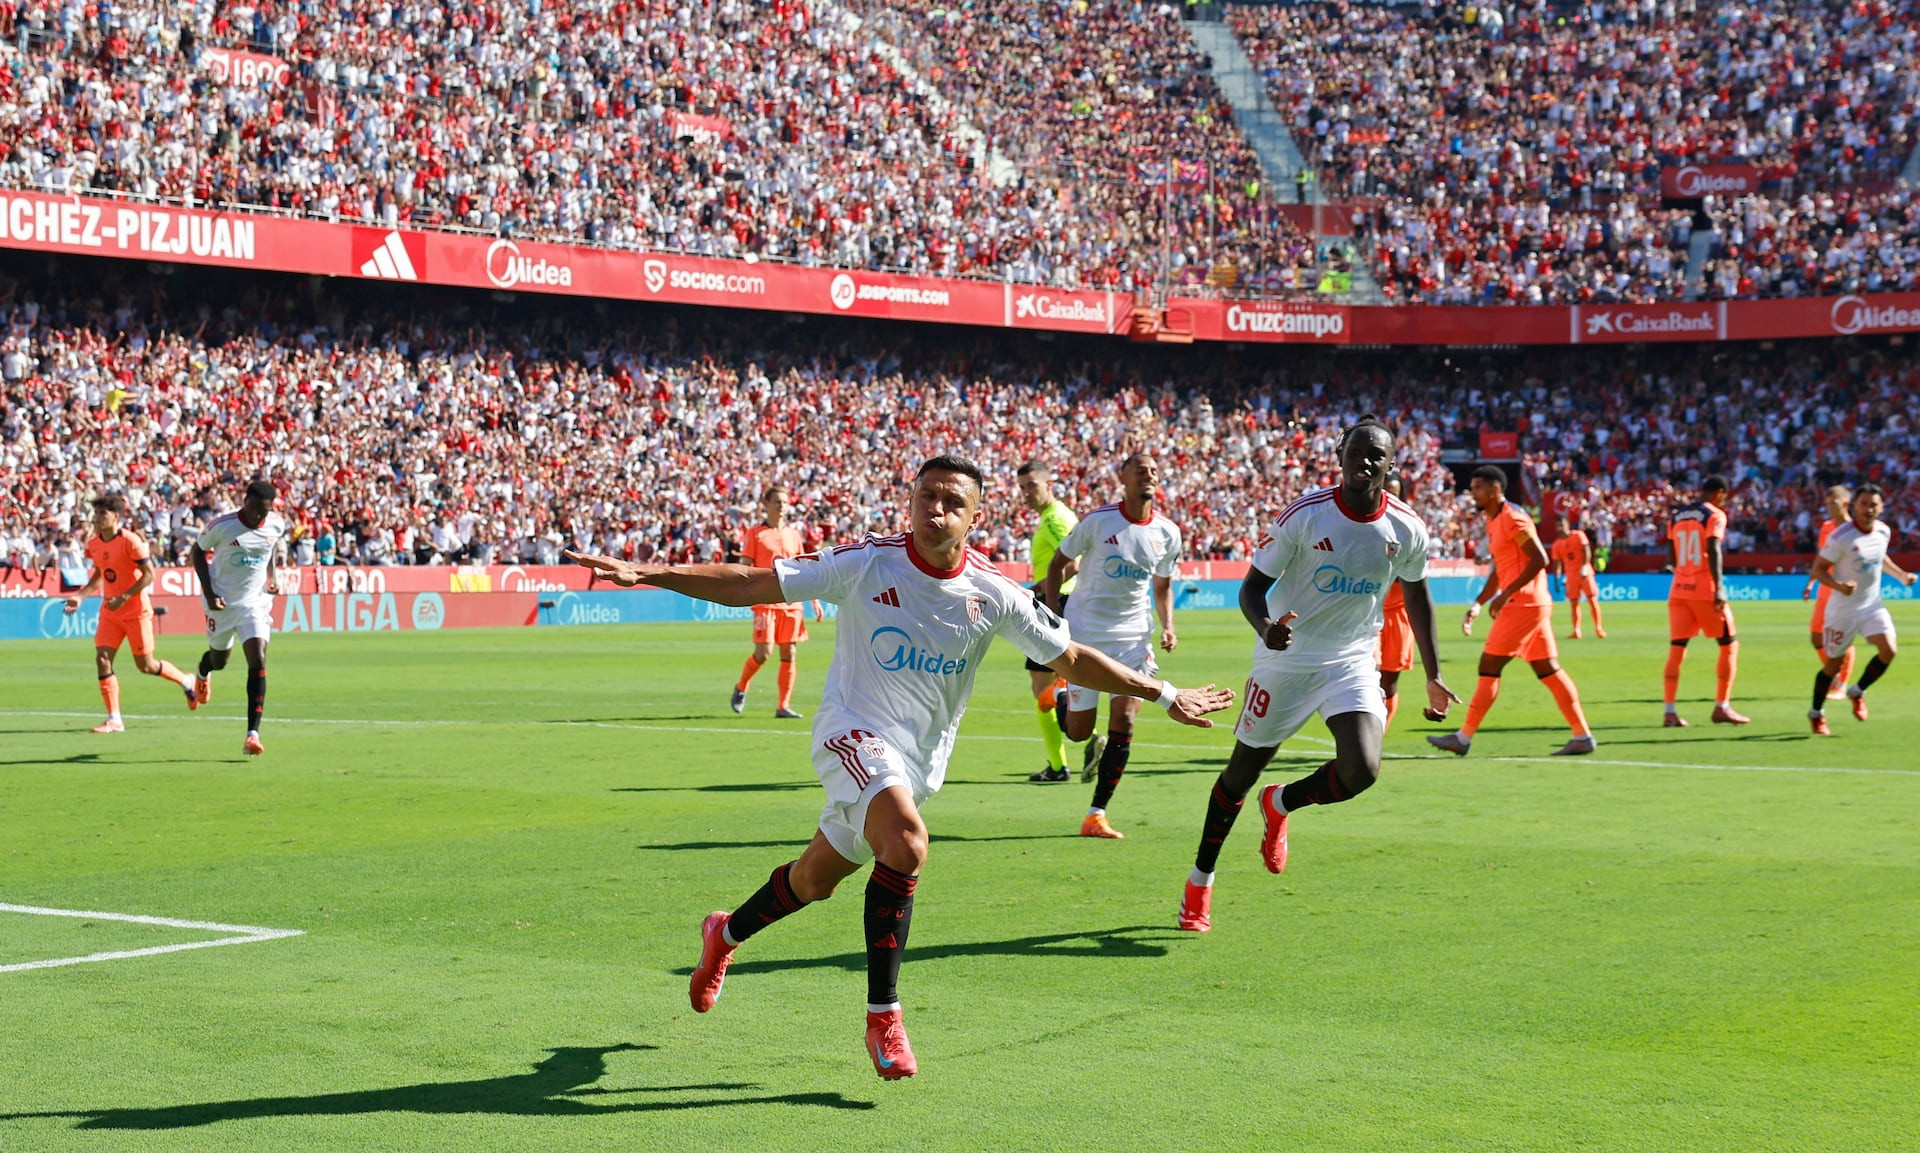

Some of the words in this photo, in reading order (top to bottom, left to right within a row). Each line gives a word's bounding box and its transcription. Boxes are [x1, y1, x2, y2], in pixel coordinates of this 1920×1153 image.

[498, 254, 573, 287] Midea
[1036, 296, 1106, 323] CaixaBank
[1226, 304, 1344, 338] Cruzcampo
[1614, 311, 1714, 333] CaixaBank
[1676, 529, 1702, 567] 14
[1323, 575, 1382, 595] Midea
[1598, 583, 1639, 600] dea
[1880, 584, 1914, 599] dea
[270, 591, 400, 632] ALIGA
[418, 599, 439, 614] EA
[568, 605, 620, 625] Midea
[752, 614, 767, 631] 21
[884, 644, 967, 676] Midea
[1247, 682, 1271, 718] 19
